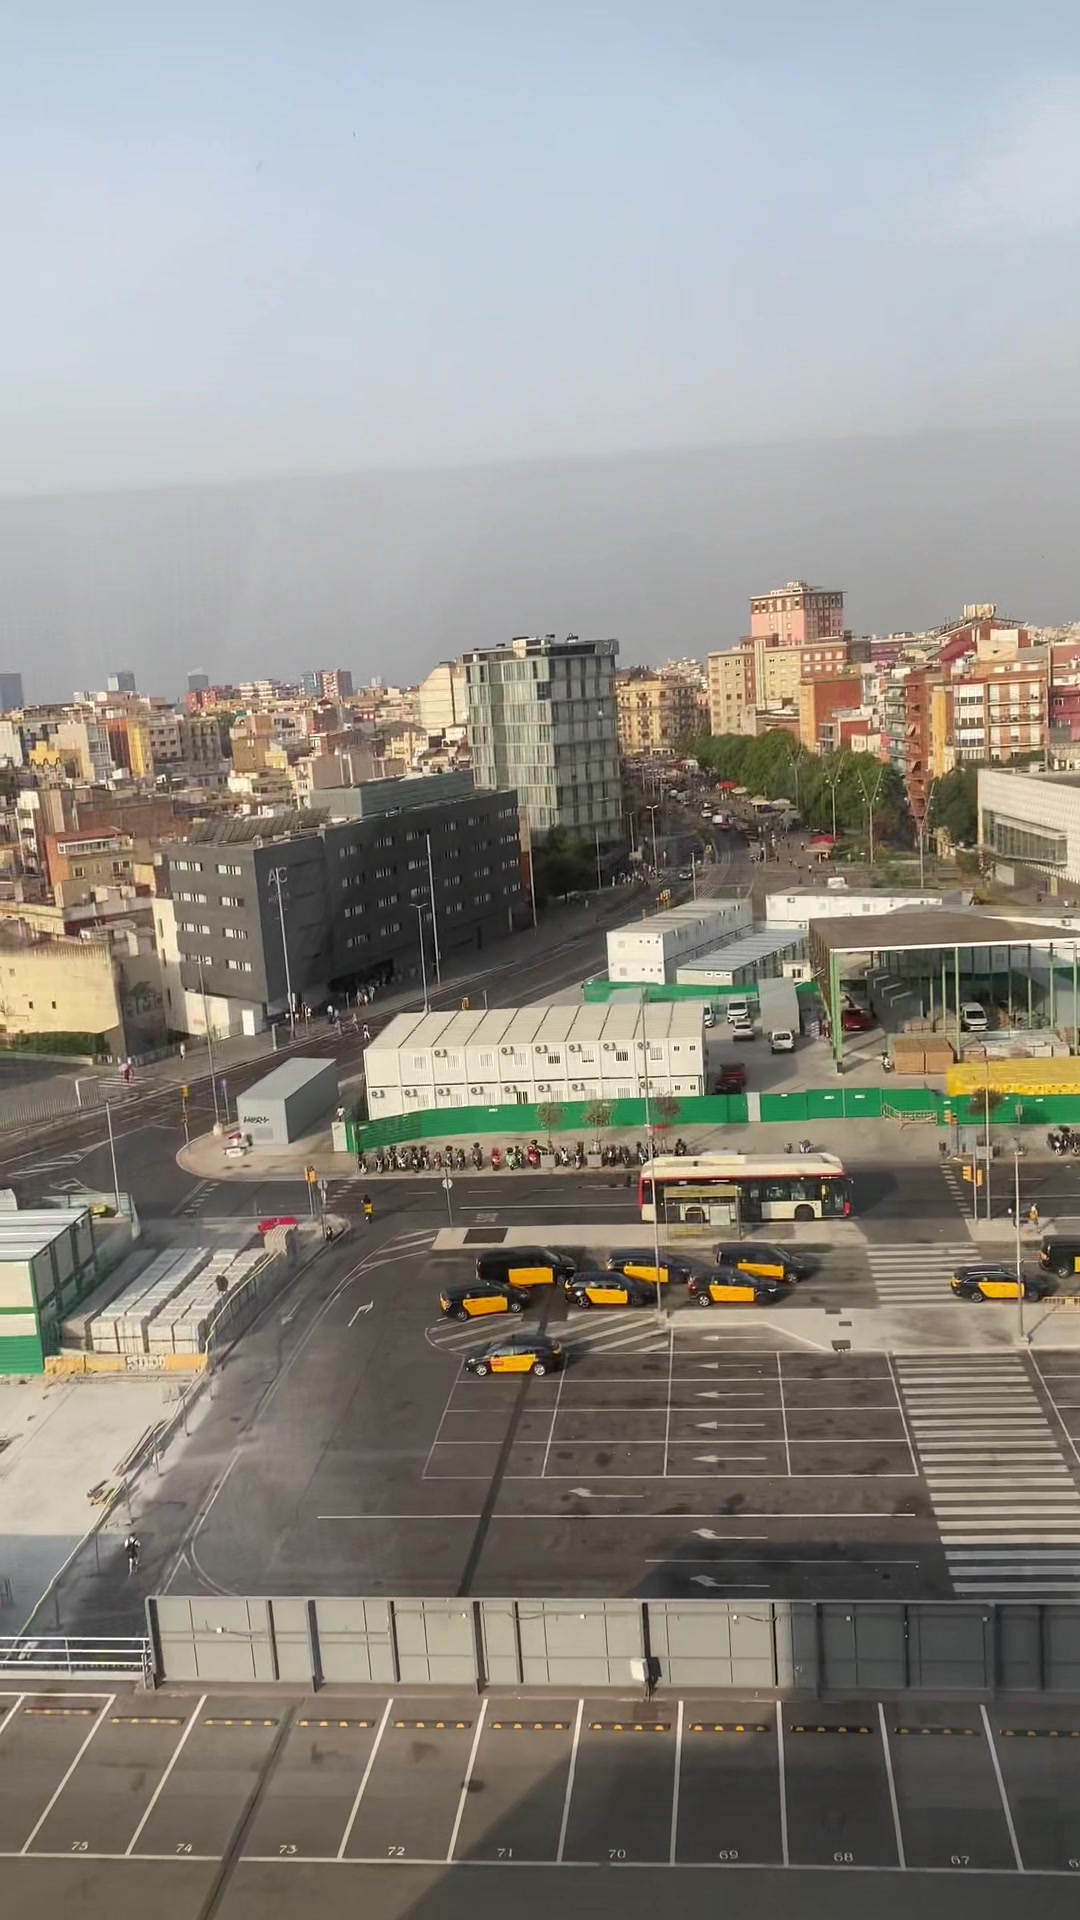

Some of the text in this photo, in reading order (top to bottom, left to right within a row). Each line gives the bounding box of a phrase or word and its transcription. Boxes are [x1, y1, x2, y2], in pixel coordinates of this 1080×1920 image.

[267, 866, 288, 887] AC
[71, 1841, 89, 1851] 75
[176, 1843, 193, 1853] 74
[279, 1844, 297, 1854] 73
[387, 1846, 405, 1856] 72
[497, 1848, 513, 1857] 71
[608, 1849, 626, 1859] 70
[719, 1850, 739, 1860] 69
[833, 1852, 854, 1862] 68
[950, 1855, 970, 1865] 67
